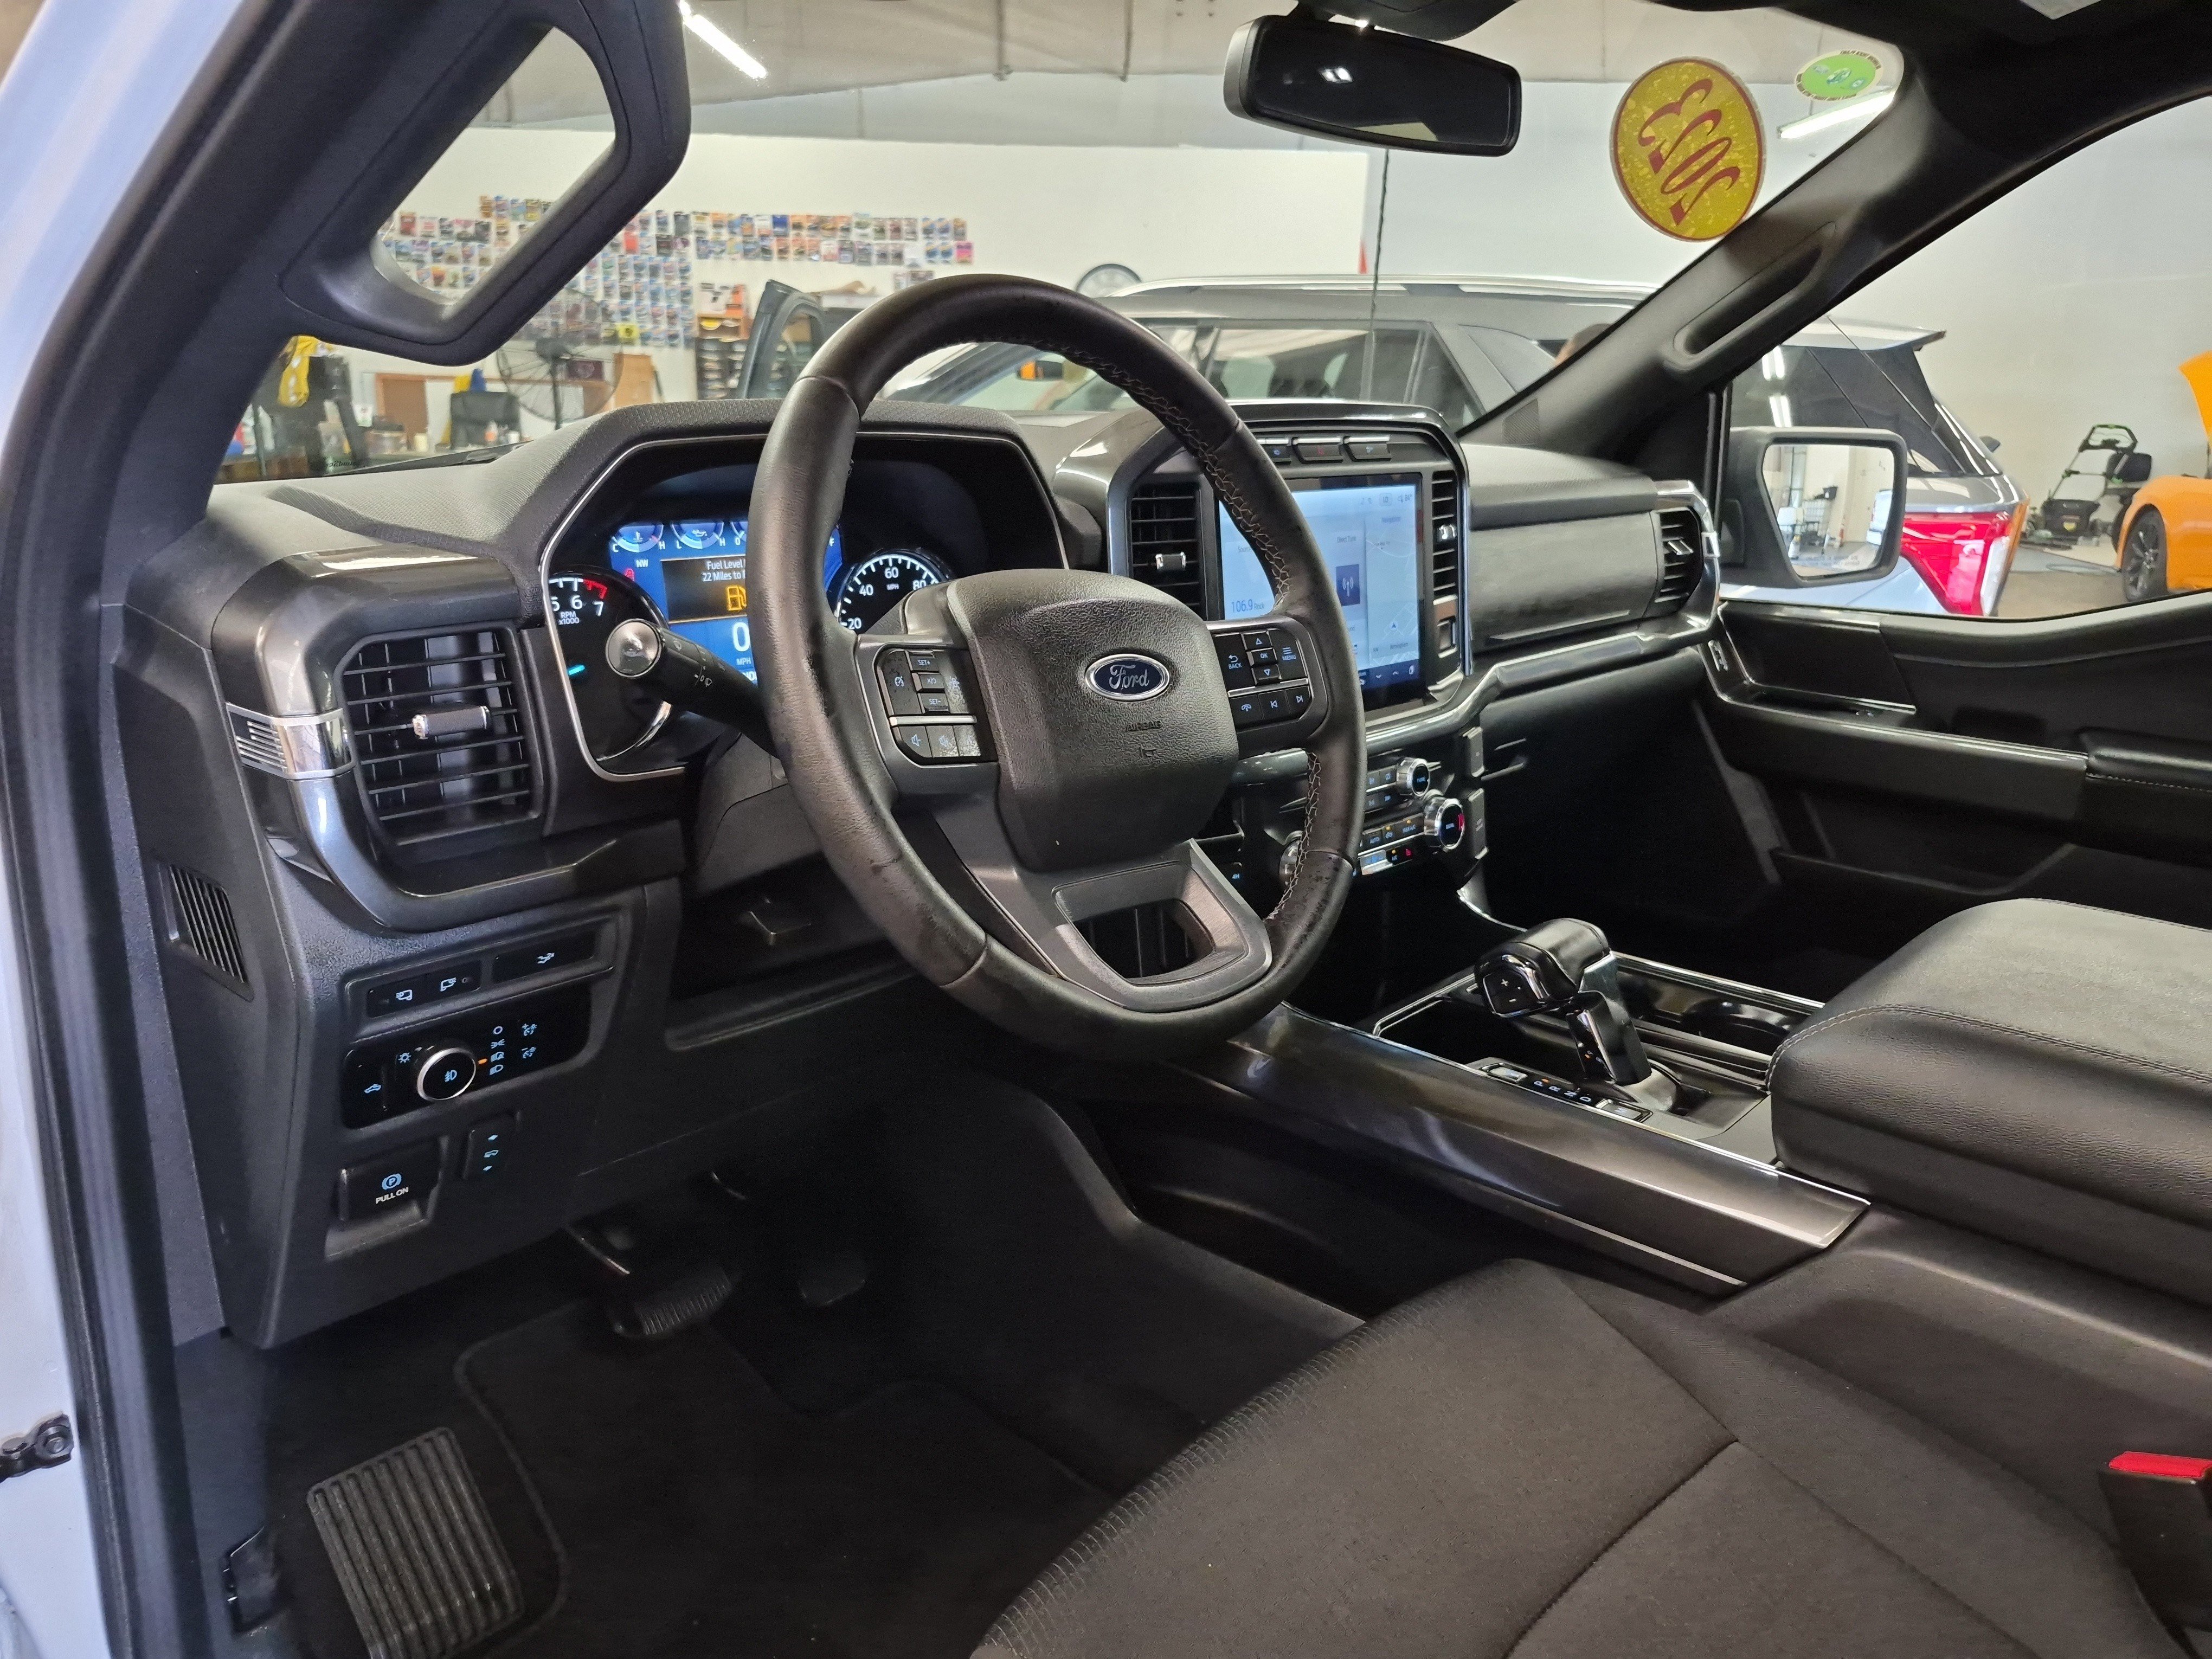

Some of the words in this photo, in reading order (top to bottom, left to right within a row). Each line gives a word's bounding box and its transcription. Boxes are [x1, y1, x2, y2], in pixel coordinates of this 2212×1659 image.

[659, 541, 666, 550] H
[676, 541, 682, 549] L
[719, 538, 726, 546] H
[612, 544, 619, 552] C
[635, 559, 649, 568] NW
[707, 561, 723, 570] Fuel
[724, 559, 743, 569] Level
[702, 573, 712, 582] 22
[713, 571, 732, 581] Miles
[733, 570, 742, 580] to
[884, 567, 899, 578] 60
[859, 584, 873, 596] 40
[570, 594, 583, 609] 6
[1231, 600, 1253, 613] 106.9
[1254, 602, 1264, 610] Rock
[592, 601, 604, 616] 7
[560, 610, 577, 619] RPM
[558, 617, 580, 625] x1000
[847, 618, 862, 630] 20
[732, 621, 750, 652] 0
[736, 657, 751, 666] MPH
[1109, 664, 1150, 691] Ford
[1126, 721, 1162, 732] AIRBAG
[375, 1193, 396, 1204] PULL
[395, 1186, 409, 1196] ON
